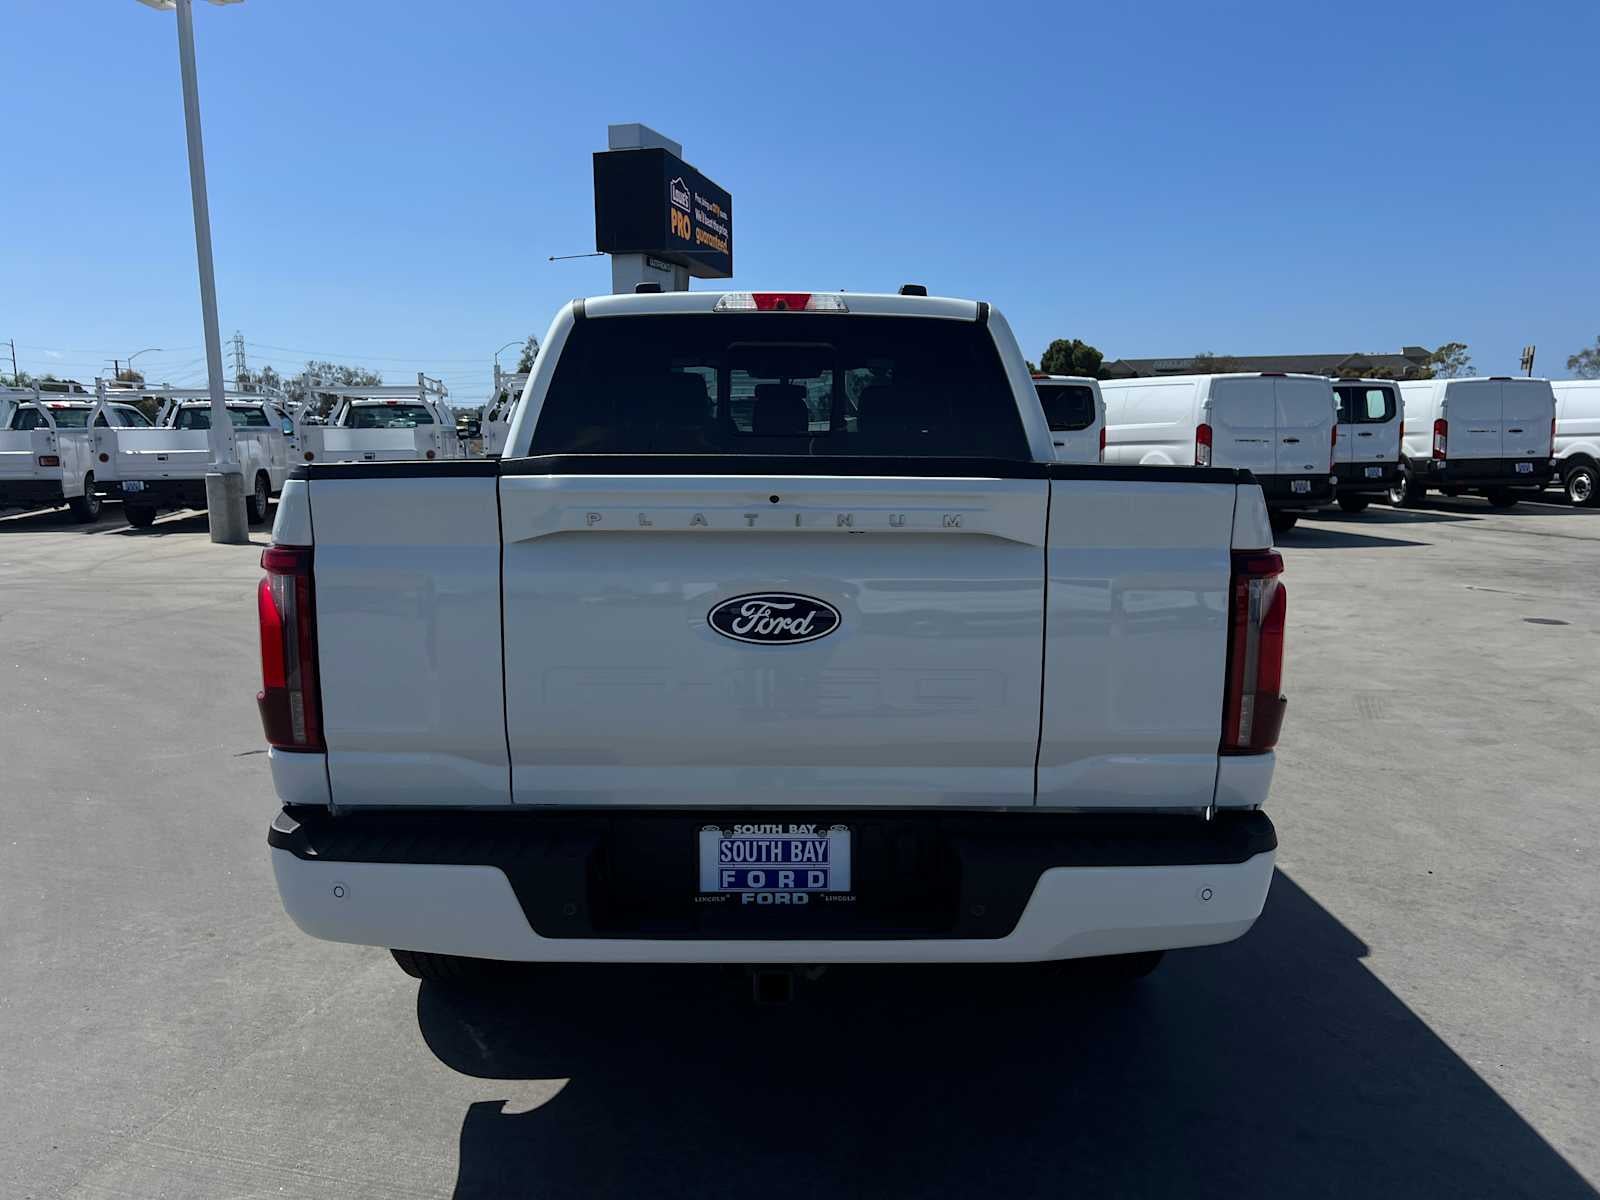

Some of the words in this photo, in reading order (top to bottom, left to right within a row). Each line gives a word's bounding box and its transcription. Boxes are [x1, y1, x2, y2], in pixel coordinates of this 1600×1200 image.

[671, 207, 691, 241] PRO
[585, 512, 962, 529] PLATINUM
[731, 600, 817, 635] Ford
[733, 824, 783, 835] SOUTH
[788, 824, 817, 835] BAY
[720, 841, 782, 862] SOUTH
[791, 841, 827, 862] BAY
[722, 870, 825, 888] FORD
[741, 893, 809, 905] FORD
